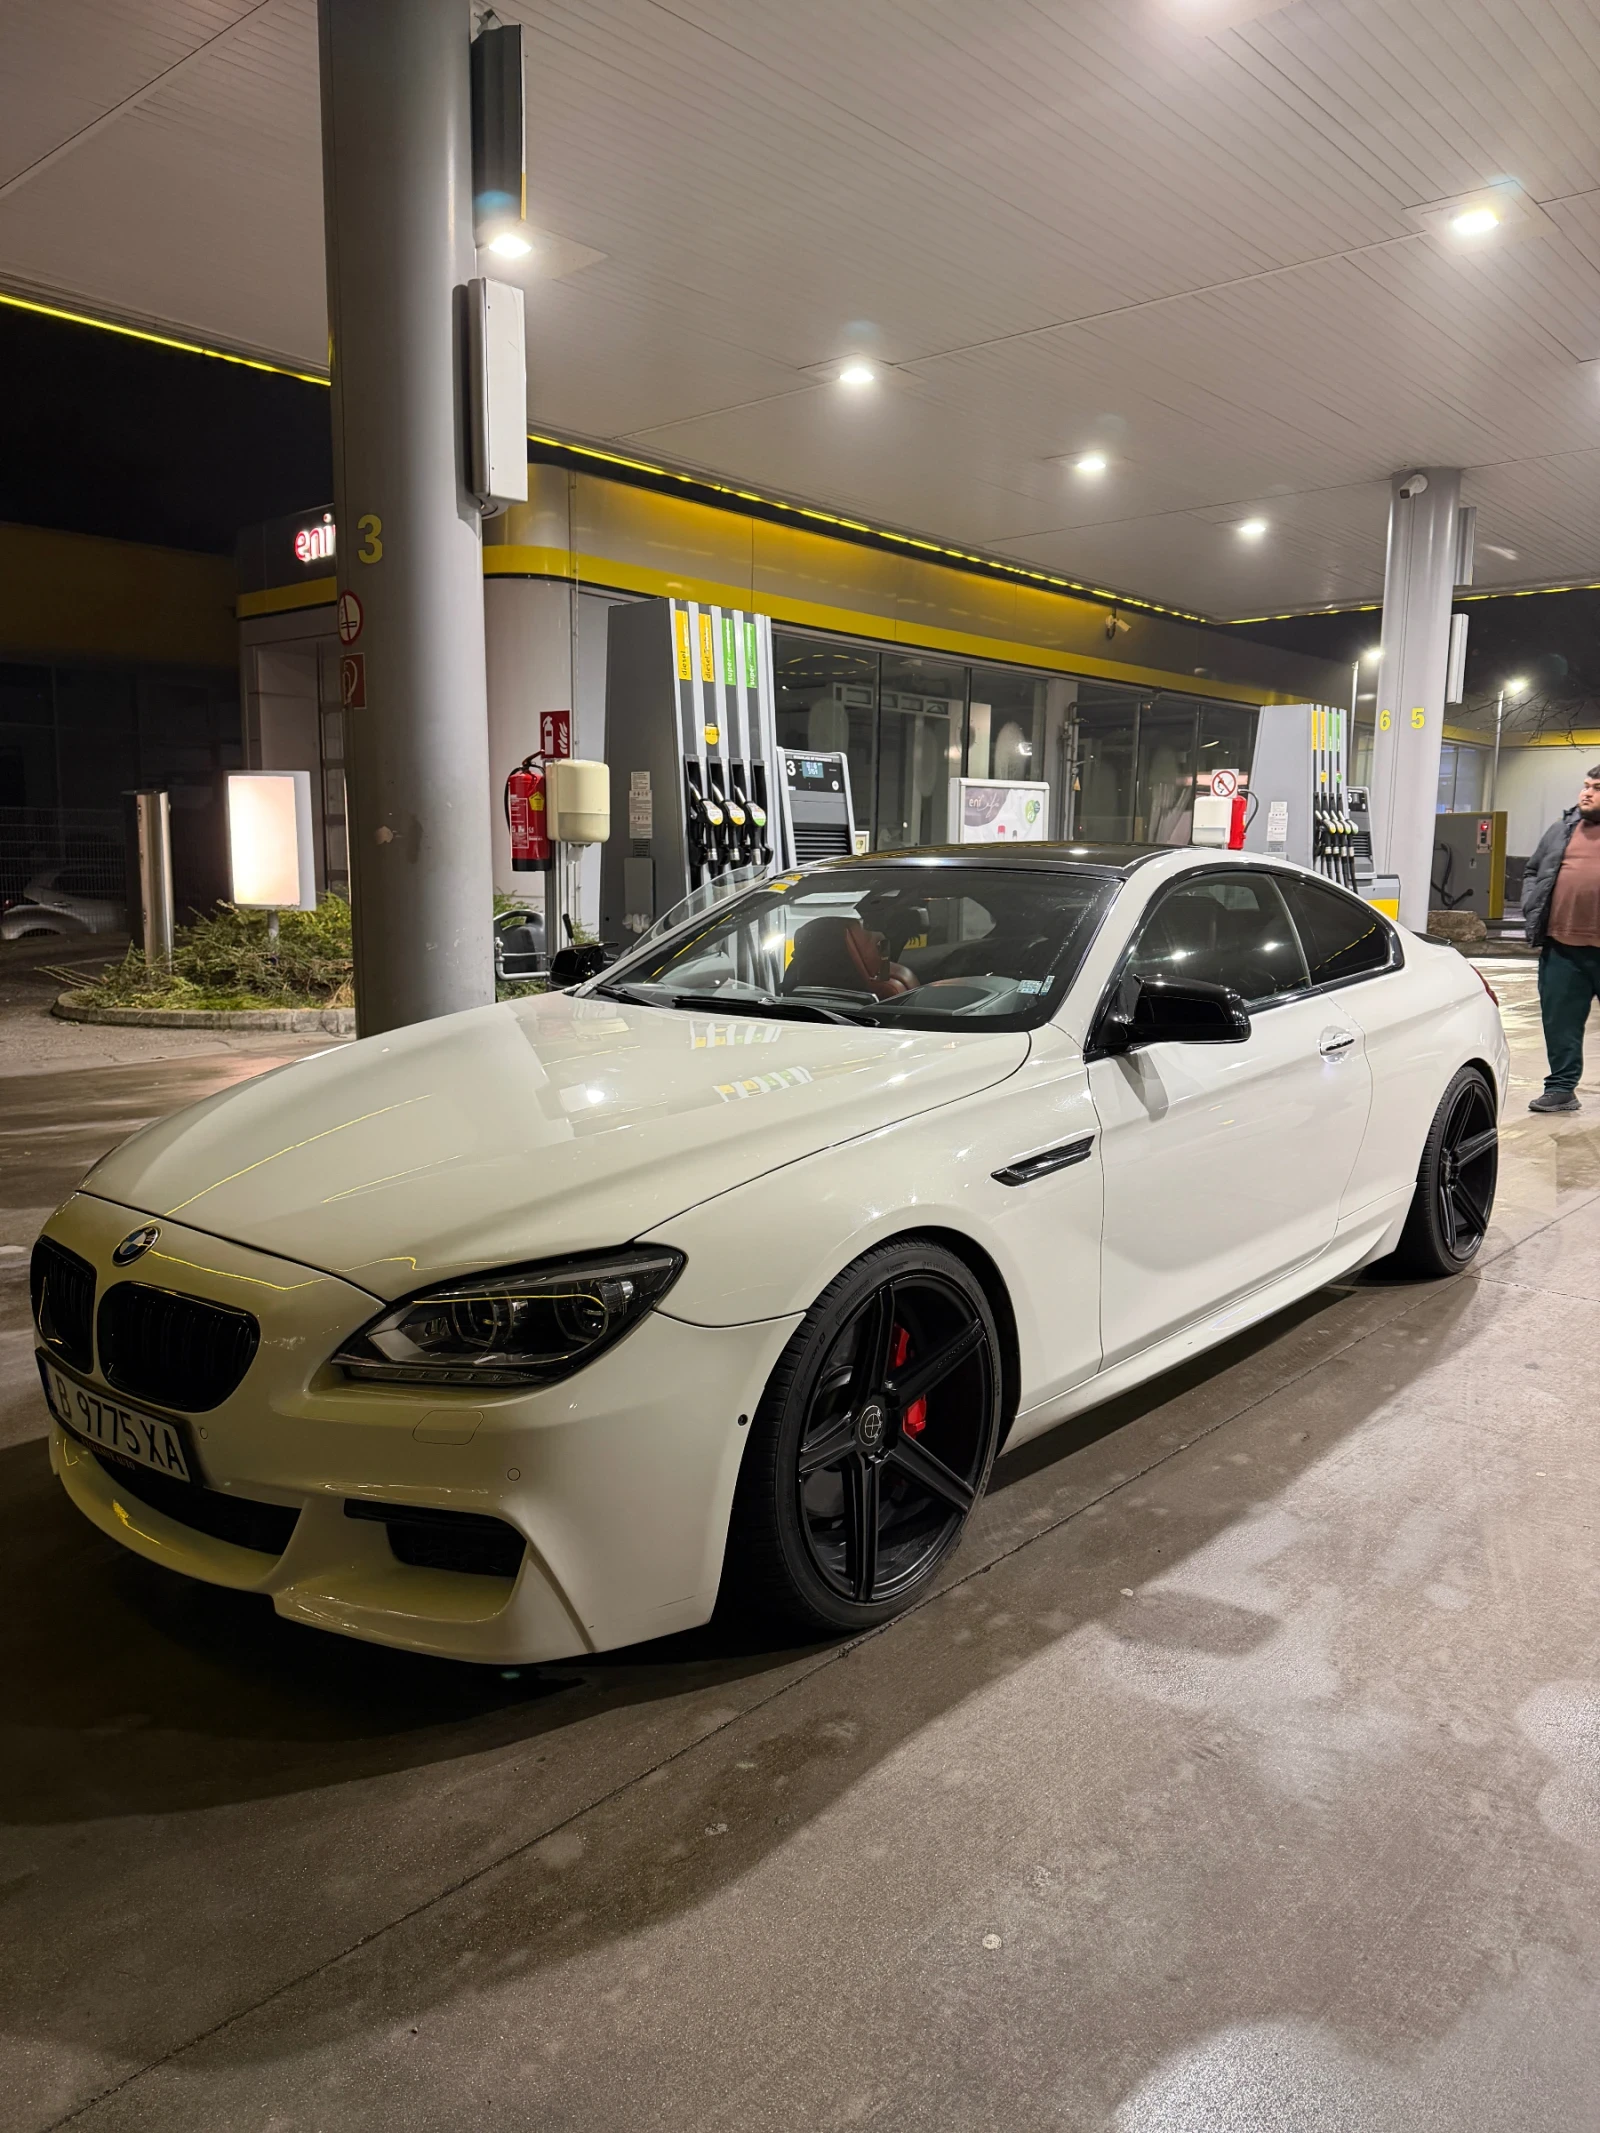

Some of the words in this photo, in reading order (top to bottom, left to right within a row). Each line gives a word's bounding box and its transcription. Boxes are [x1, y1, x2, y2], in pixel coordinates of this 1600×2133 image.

[357, 514, 383, 564] 3
[680, 650, 688, 676] diesel
[1379, 709, 1391, 731] 6
[1411, 707, 1425, 729] 5
[786, 760, 796, 777] 3
[55, 1373, 72, 1420] B
[77, 1390, 140, 1455] 9775
[140, 1418, 186, 1476] XA
